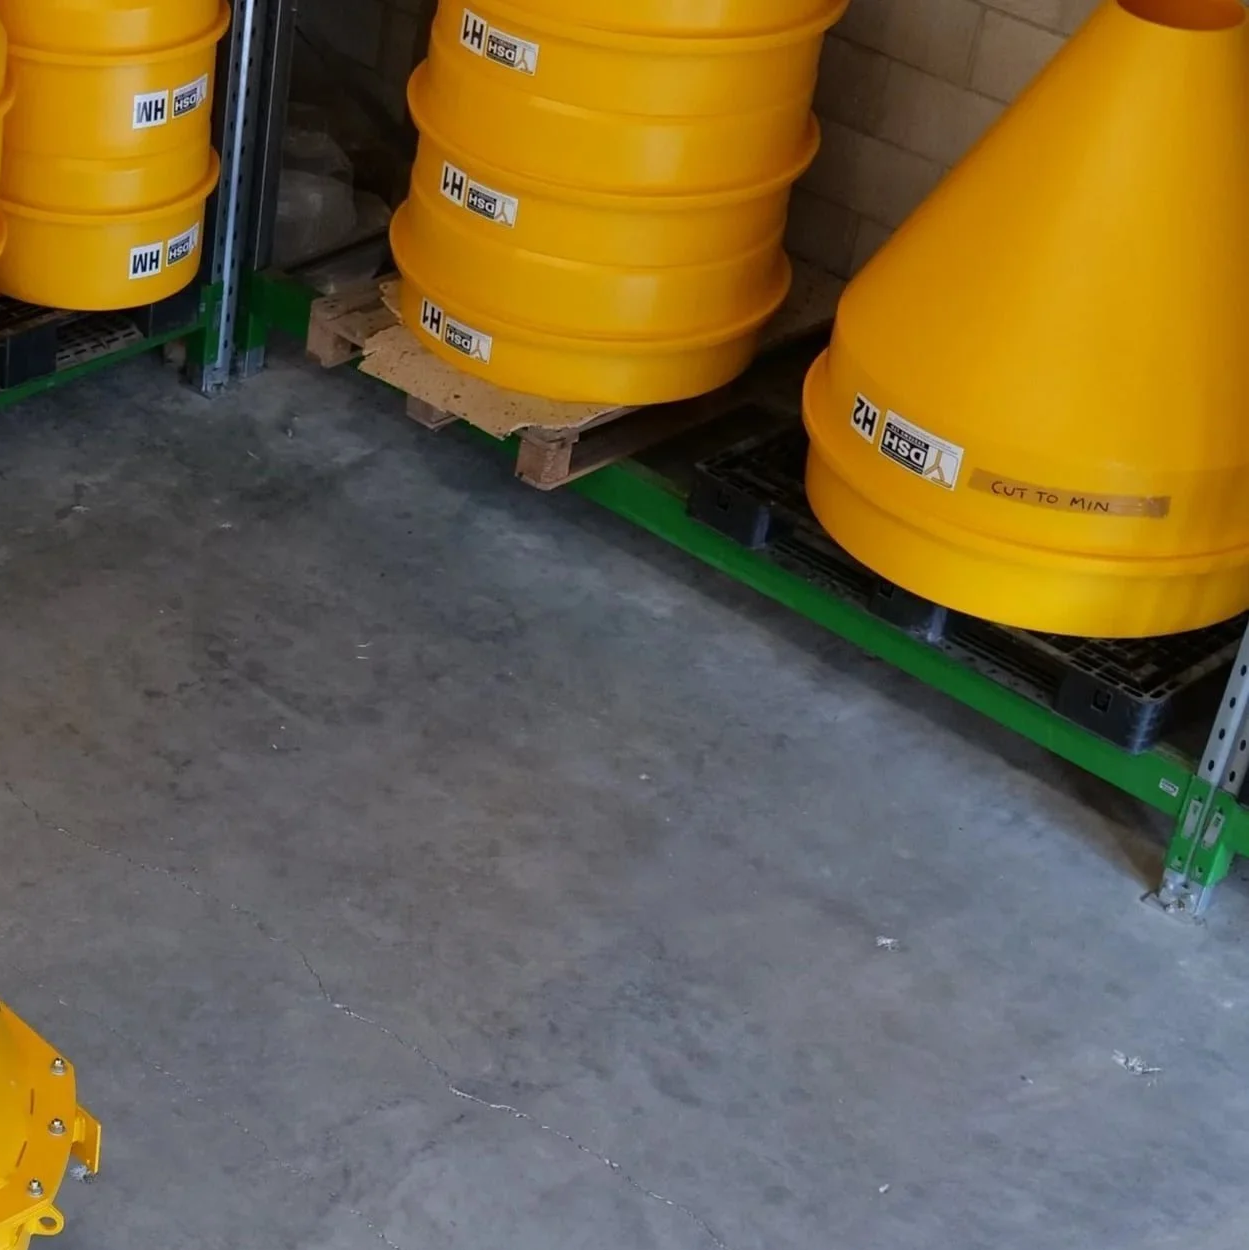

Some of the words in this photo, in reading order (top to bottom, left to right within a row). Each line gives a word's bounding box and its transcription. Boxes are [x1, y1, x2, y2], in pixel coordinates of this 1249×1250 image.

[462, 14, 484, 50] H1
[488, 40, 516, 61] DSH
[136, 98, 165, 123] HM
[175, 93, 196, 111] DSH
[442, 166, 464, 201] H1
[468, 193, 495, 213] DSH
[132, 249, 160, 275] HM
[422, 300, 442, 334] H1
[446, 328, 471, 350] DSH
[853, 396, 877, 437] H2
[883, 430, 927, 467] DSH
[991, 480, 1027, 498] CUT
[1037, 491, 1059, 504] TO
[1070, 497, 1110, 513] MIN
